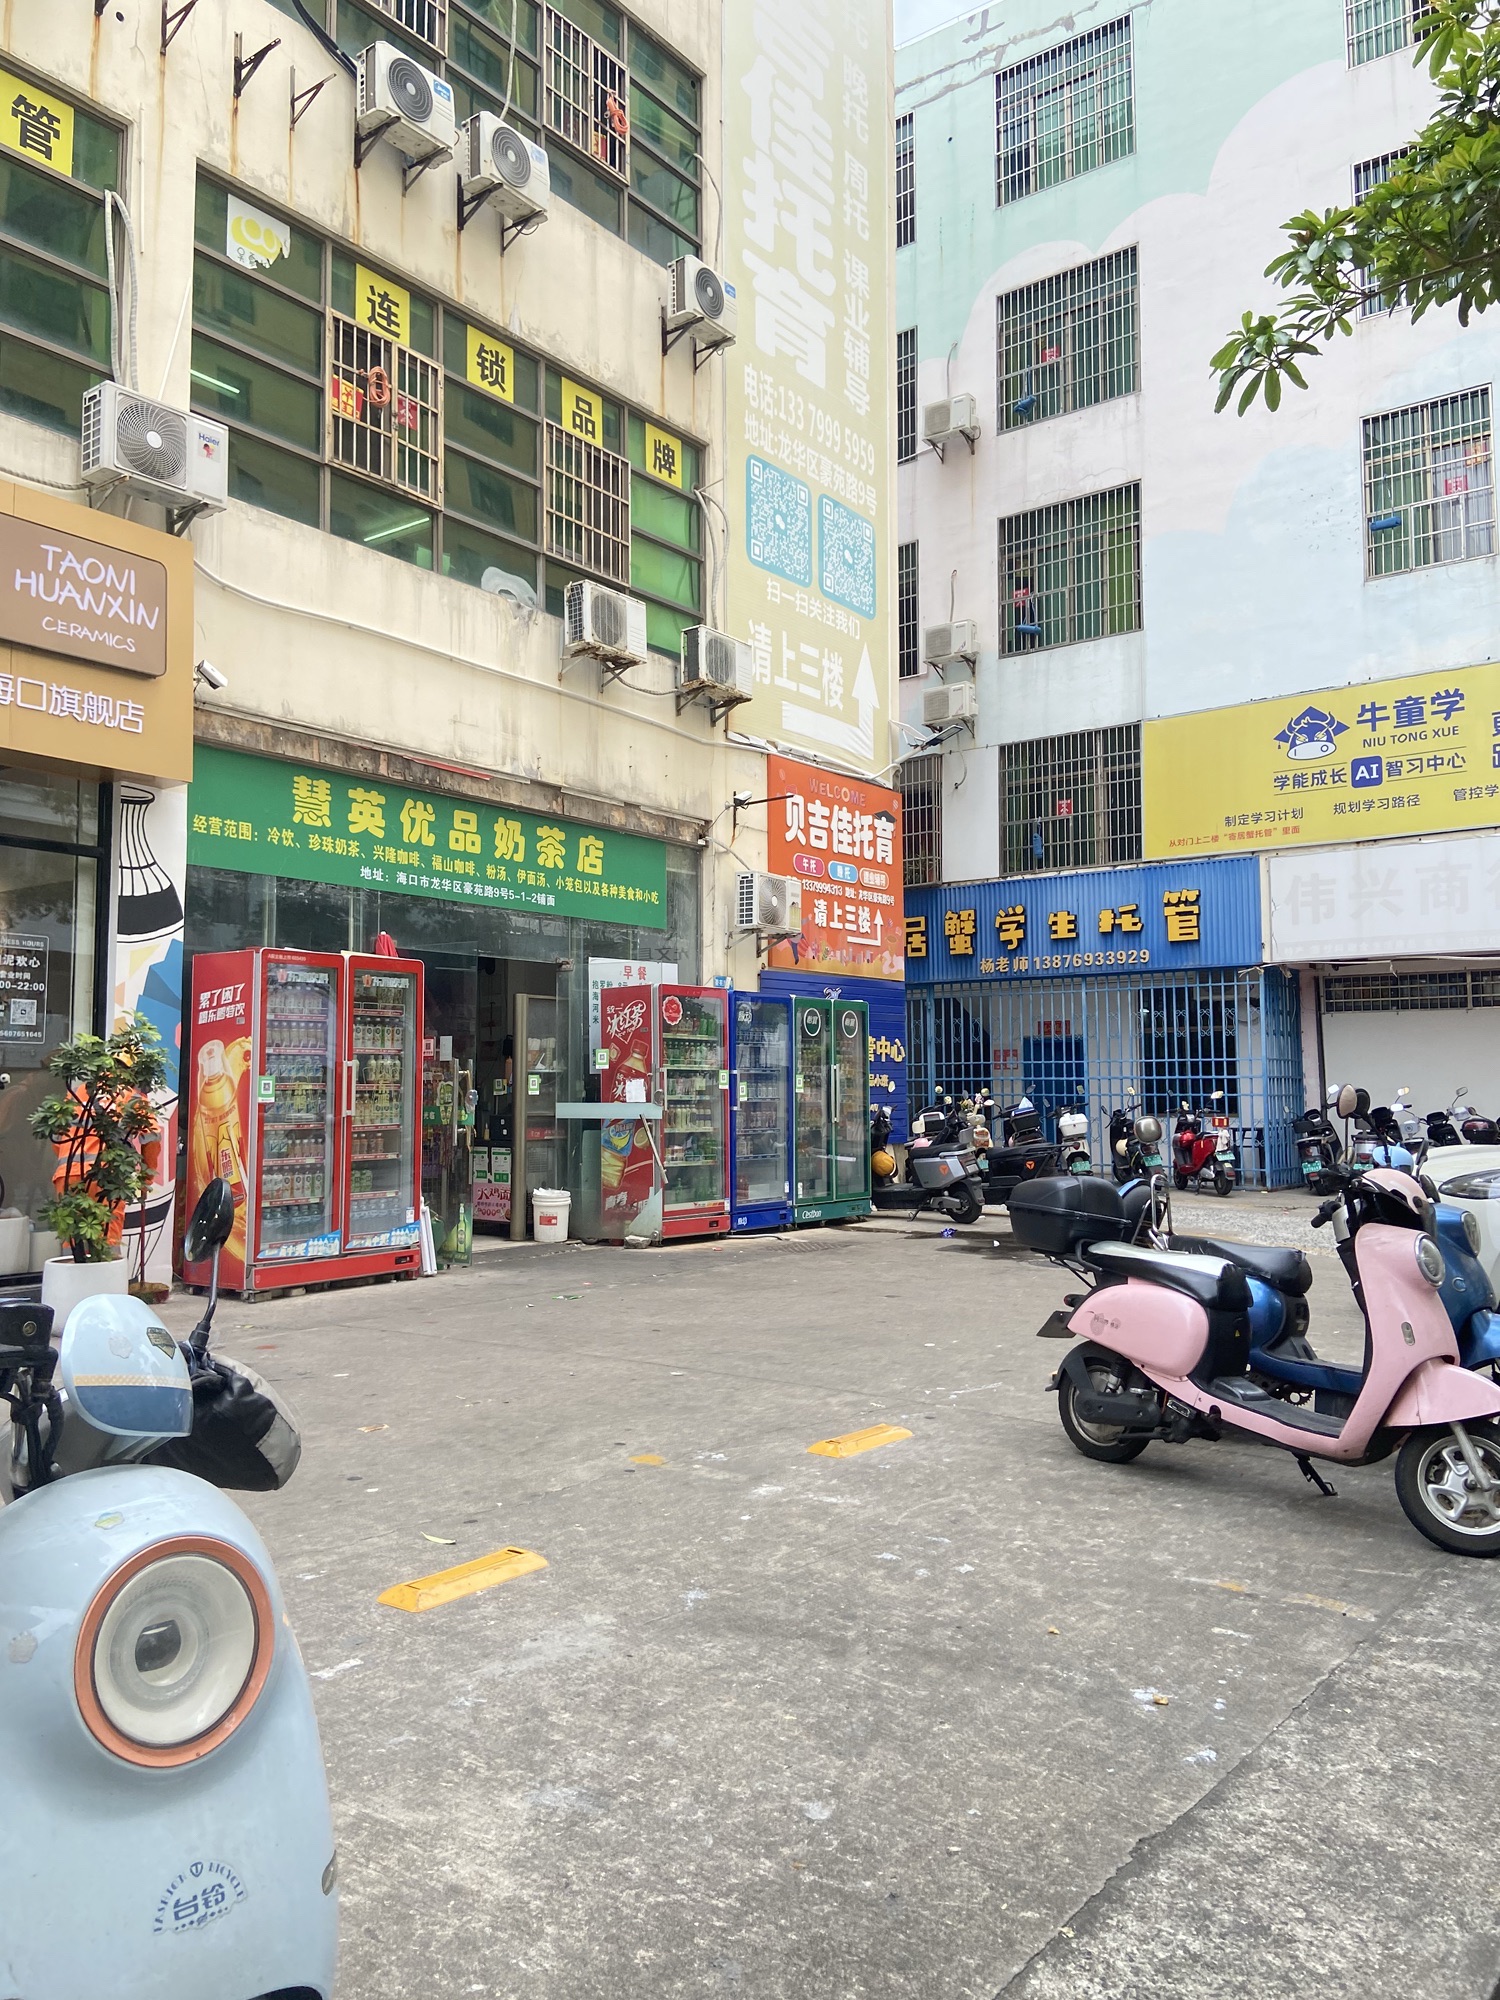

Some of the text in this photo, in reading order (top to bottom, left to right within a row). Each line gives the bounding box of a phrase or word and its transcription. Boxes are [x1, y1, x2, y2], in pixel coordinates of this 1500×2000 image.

[10, 94, 61, 160] 管
[843, 150, 870, 242] 周托
[843, 249, 871, 418] 课业辅导
[198, 432, 220, 447] Haier
[808, 402, 841, 453] 7999
[845, 427, 875, 476] 5959
[40, 544, 136, 595] TAONI
[15, 568, 160, 630] HUANXIN
[766, 577, 861, 640] 扫一扫关注我们
[42, 616, 136, 653] CERAMICS
[748, 619, 844, 711] 请上三楼
[1356, 687, 1465, 733] 牛童学
[1362, 725, 1459, 748] NIU TONG XUE
[809, 777, 867, 807] WELCOME
[1273, 767, 1348, 791] 学能成长
[1354, 763, 1380, 781] AI
[1386, 752, 1467, 778] 智习中心
[292, 774, 606, 876] 慧英优品奶茶店
[785, 792, 894, 865] 贝吉佳托育
[1224, 806, 1304, 828] 制定学习计划
[1333, 793, 1421, 816] 规划学习路径
[1284, 858, 1500, 926] 伟兴商
[814, 899, 871, 934] 请上三楼
[0, 954, 40, 968] 泥欢心
[623, 966, 647, 981] 早餐
[980, 949, 1150, 974] 杨老师 13876933929
[199, 983, 246, 1010] 累了困了
